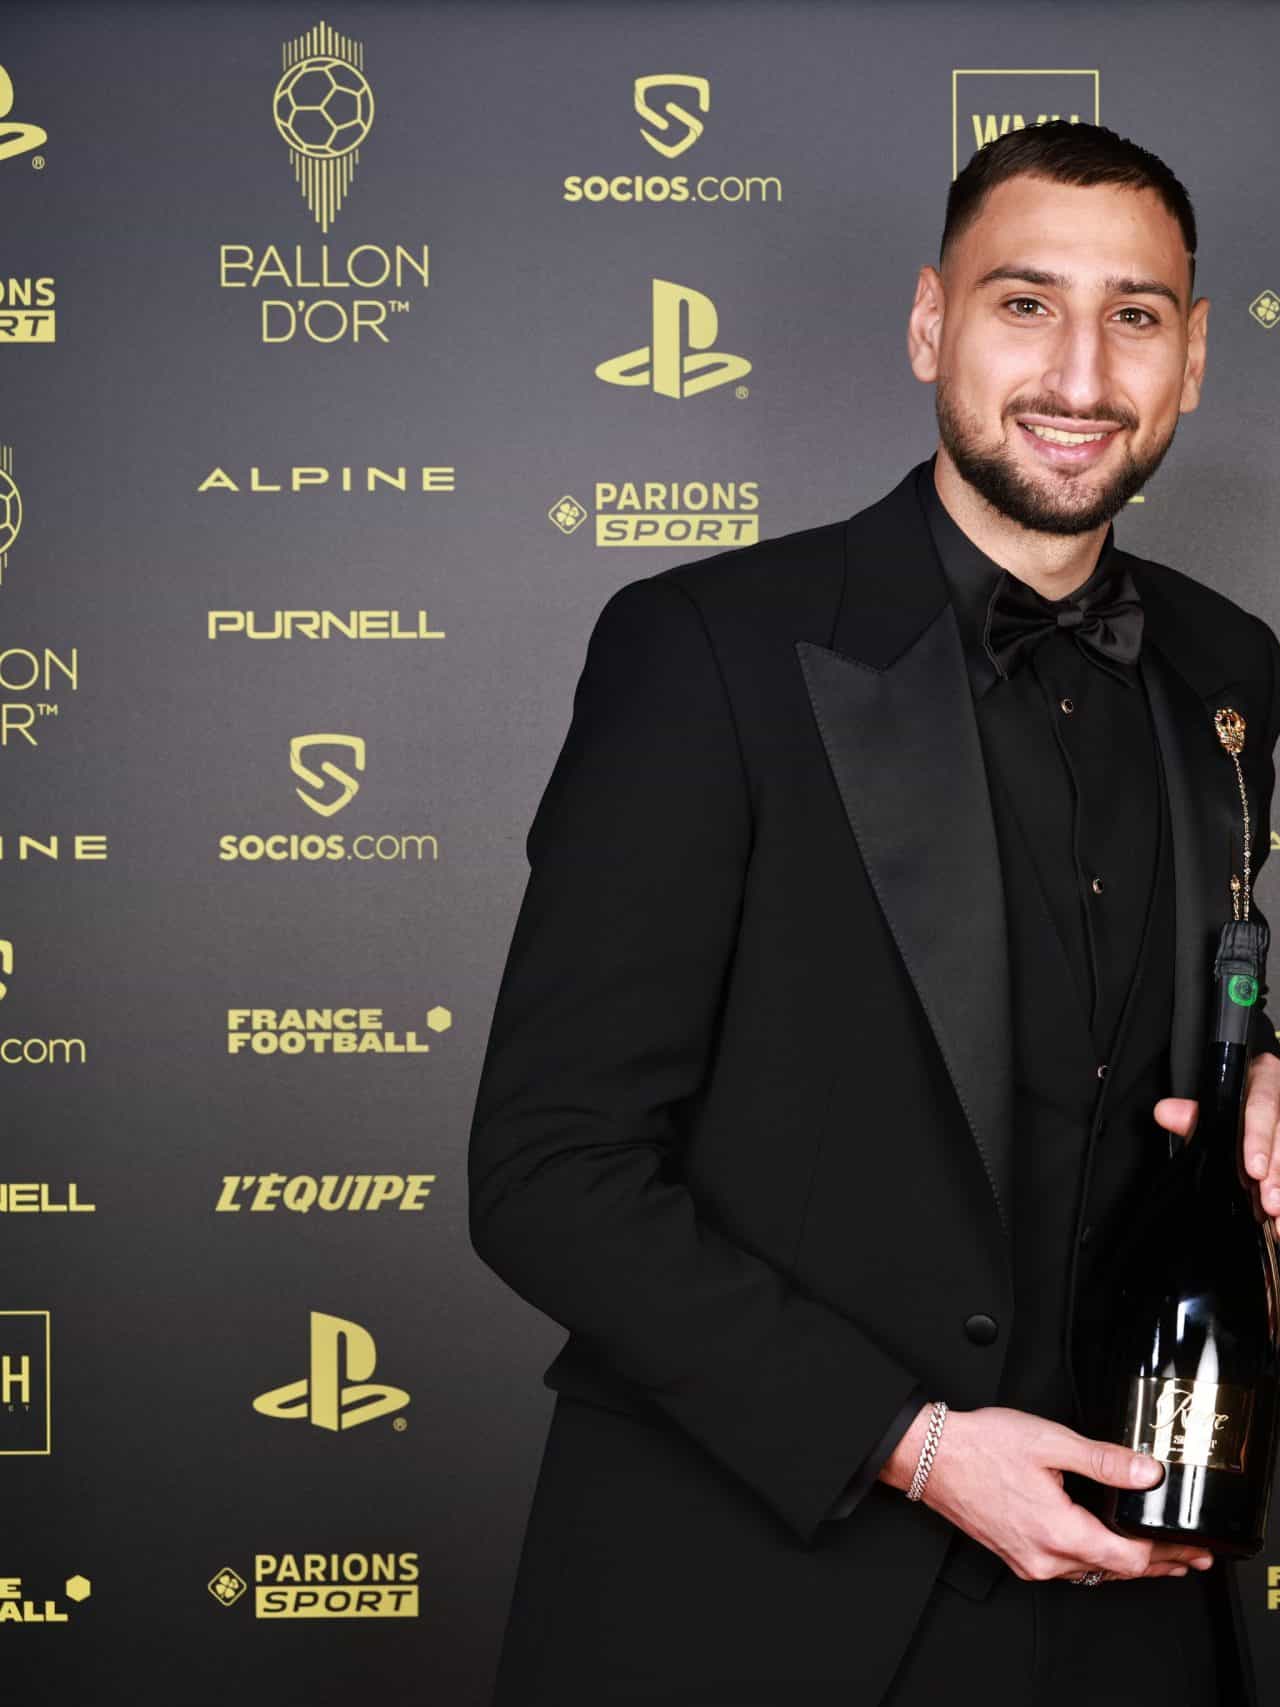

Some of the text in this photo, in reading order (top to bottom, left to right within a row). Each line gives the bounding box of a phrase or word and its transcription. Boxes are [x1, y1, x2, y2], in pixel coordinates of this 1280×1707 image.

[564, 176, 782, 202] SOCIOS.com
[221, 244, 429, 288] BALLON
[199, 467, 454, 492] ALPINE
[596, 482, 758, 510] PARIONS
[603, 519, 753, 542] SPORT
[208, 609, 445, 640] PURNELL
[220, 834, 438, 861] SOCIOS.com
[226, 1008, 384, 1031] FRANCE
[227, 1031, 430, 1055] FOOTBALL
[253, 1552, 420, 1582] PARIONS
[262, 1590, 414, 1613] SPORT
